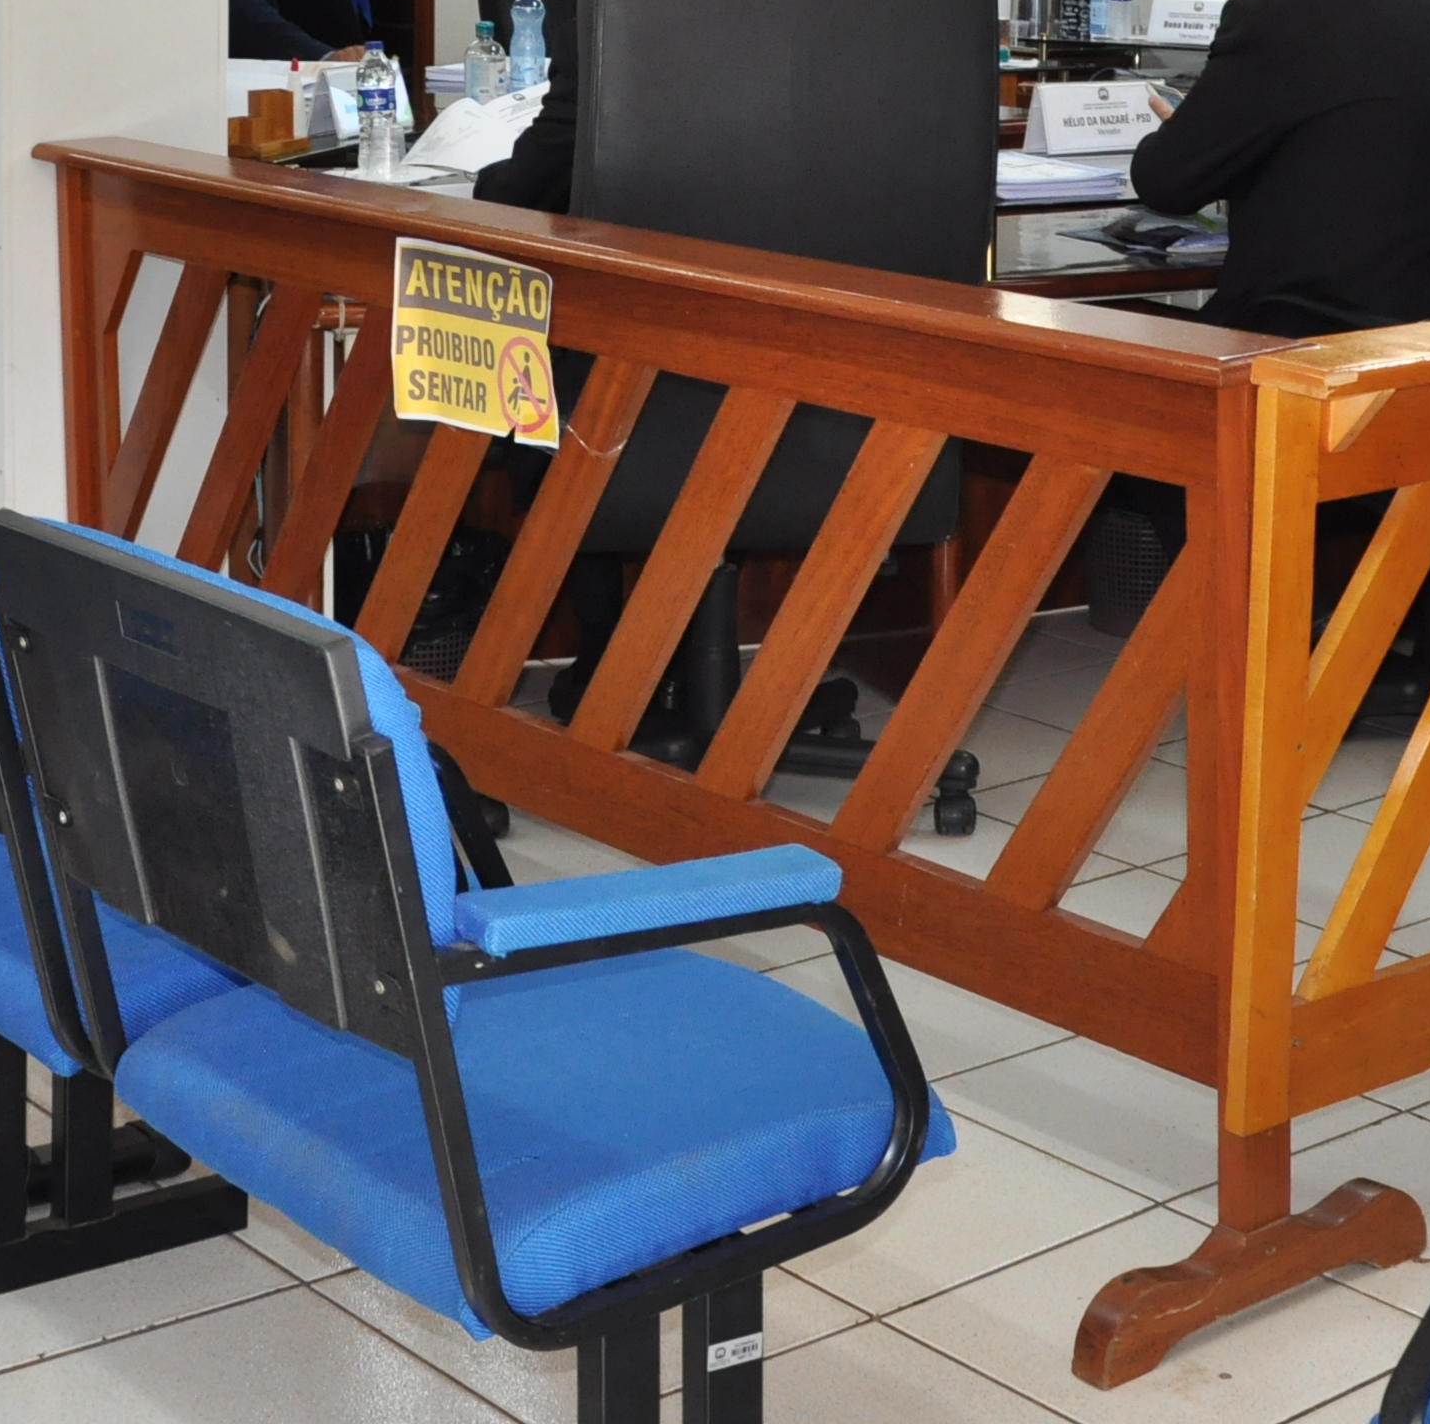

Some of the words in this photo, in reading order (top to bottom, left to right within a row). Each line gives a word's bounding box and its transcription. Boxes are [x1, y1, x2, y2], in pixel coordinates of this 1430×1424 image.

[1063, 114, 1085, 127] HÉLIO
[1087, 116, 1099, 126] DA
[1100, 113, 1129, 125] NAZARÉ
[1136, 113, 1151, 123] PSD
[405, 258, 547, 321] ATENÇÃO
[396, 324, 495, 371] PROIBIDO
[408, 368, 487, 414] SENTAR
